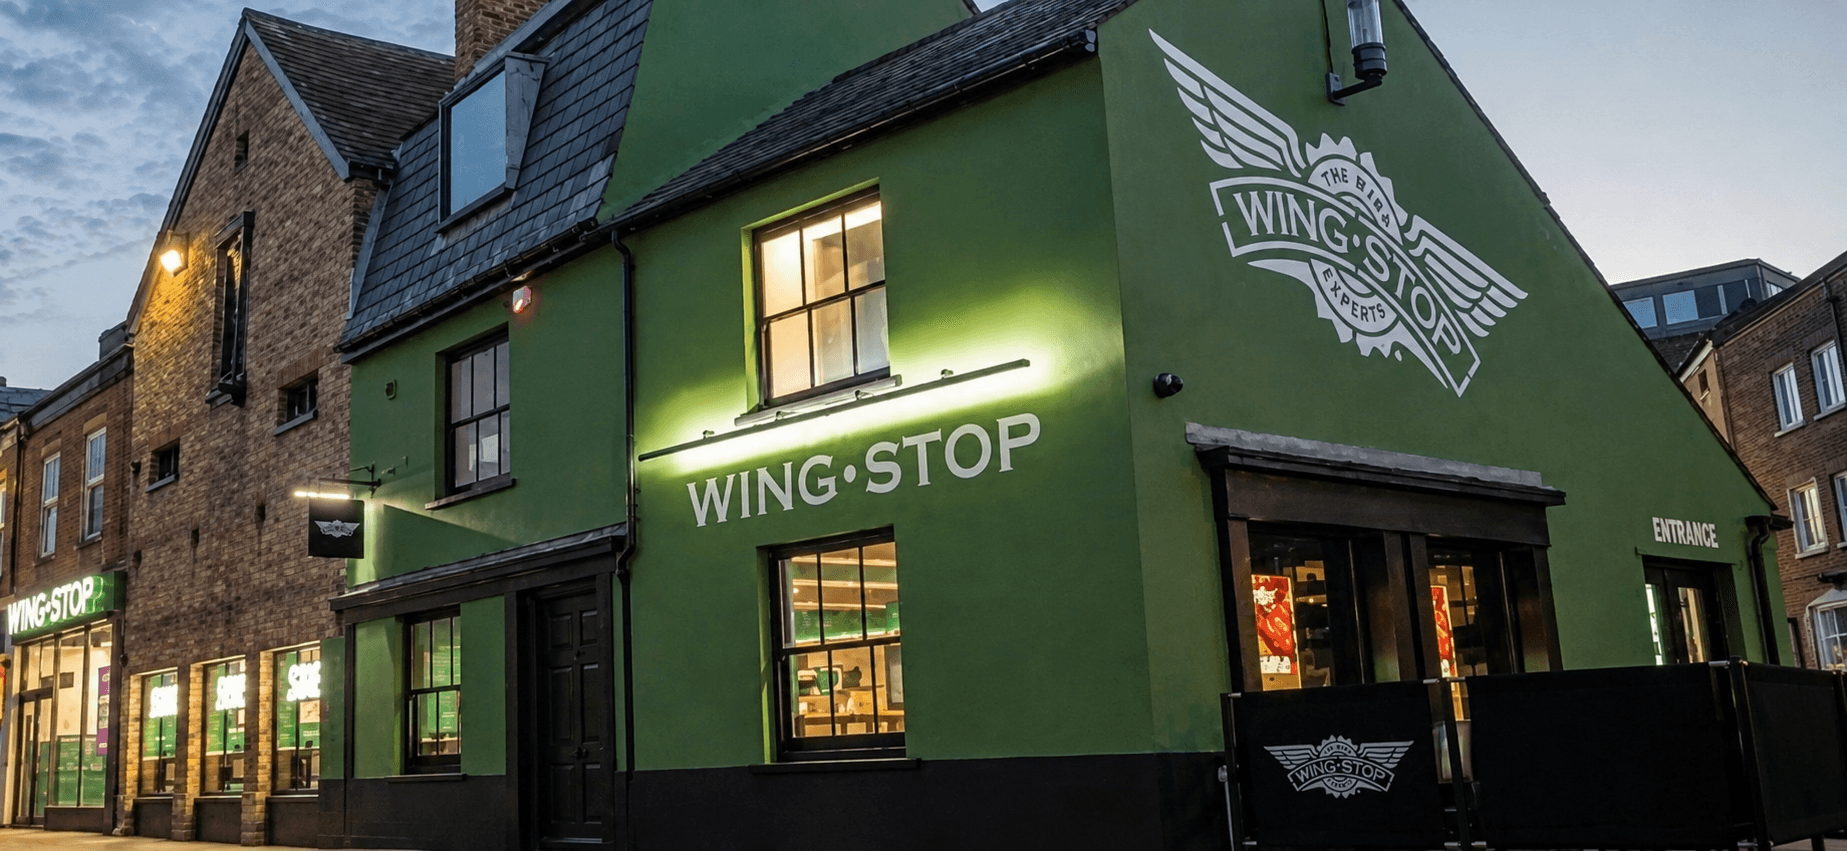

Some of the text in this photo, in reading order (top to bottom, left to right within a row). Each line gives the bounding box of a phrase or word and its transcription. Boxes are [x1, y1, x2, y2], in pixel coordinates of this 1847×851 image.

[1321, 167, 1348, 187] THE
[1322, 268, 1386, 322] EXPERTS
[1651, 517, 1719, 548] ENTRANCE
